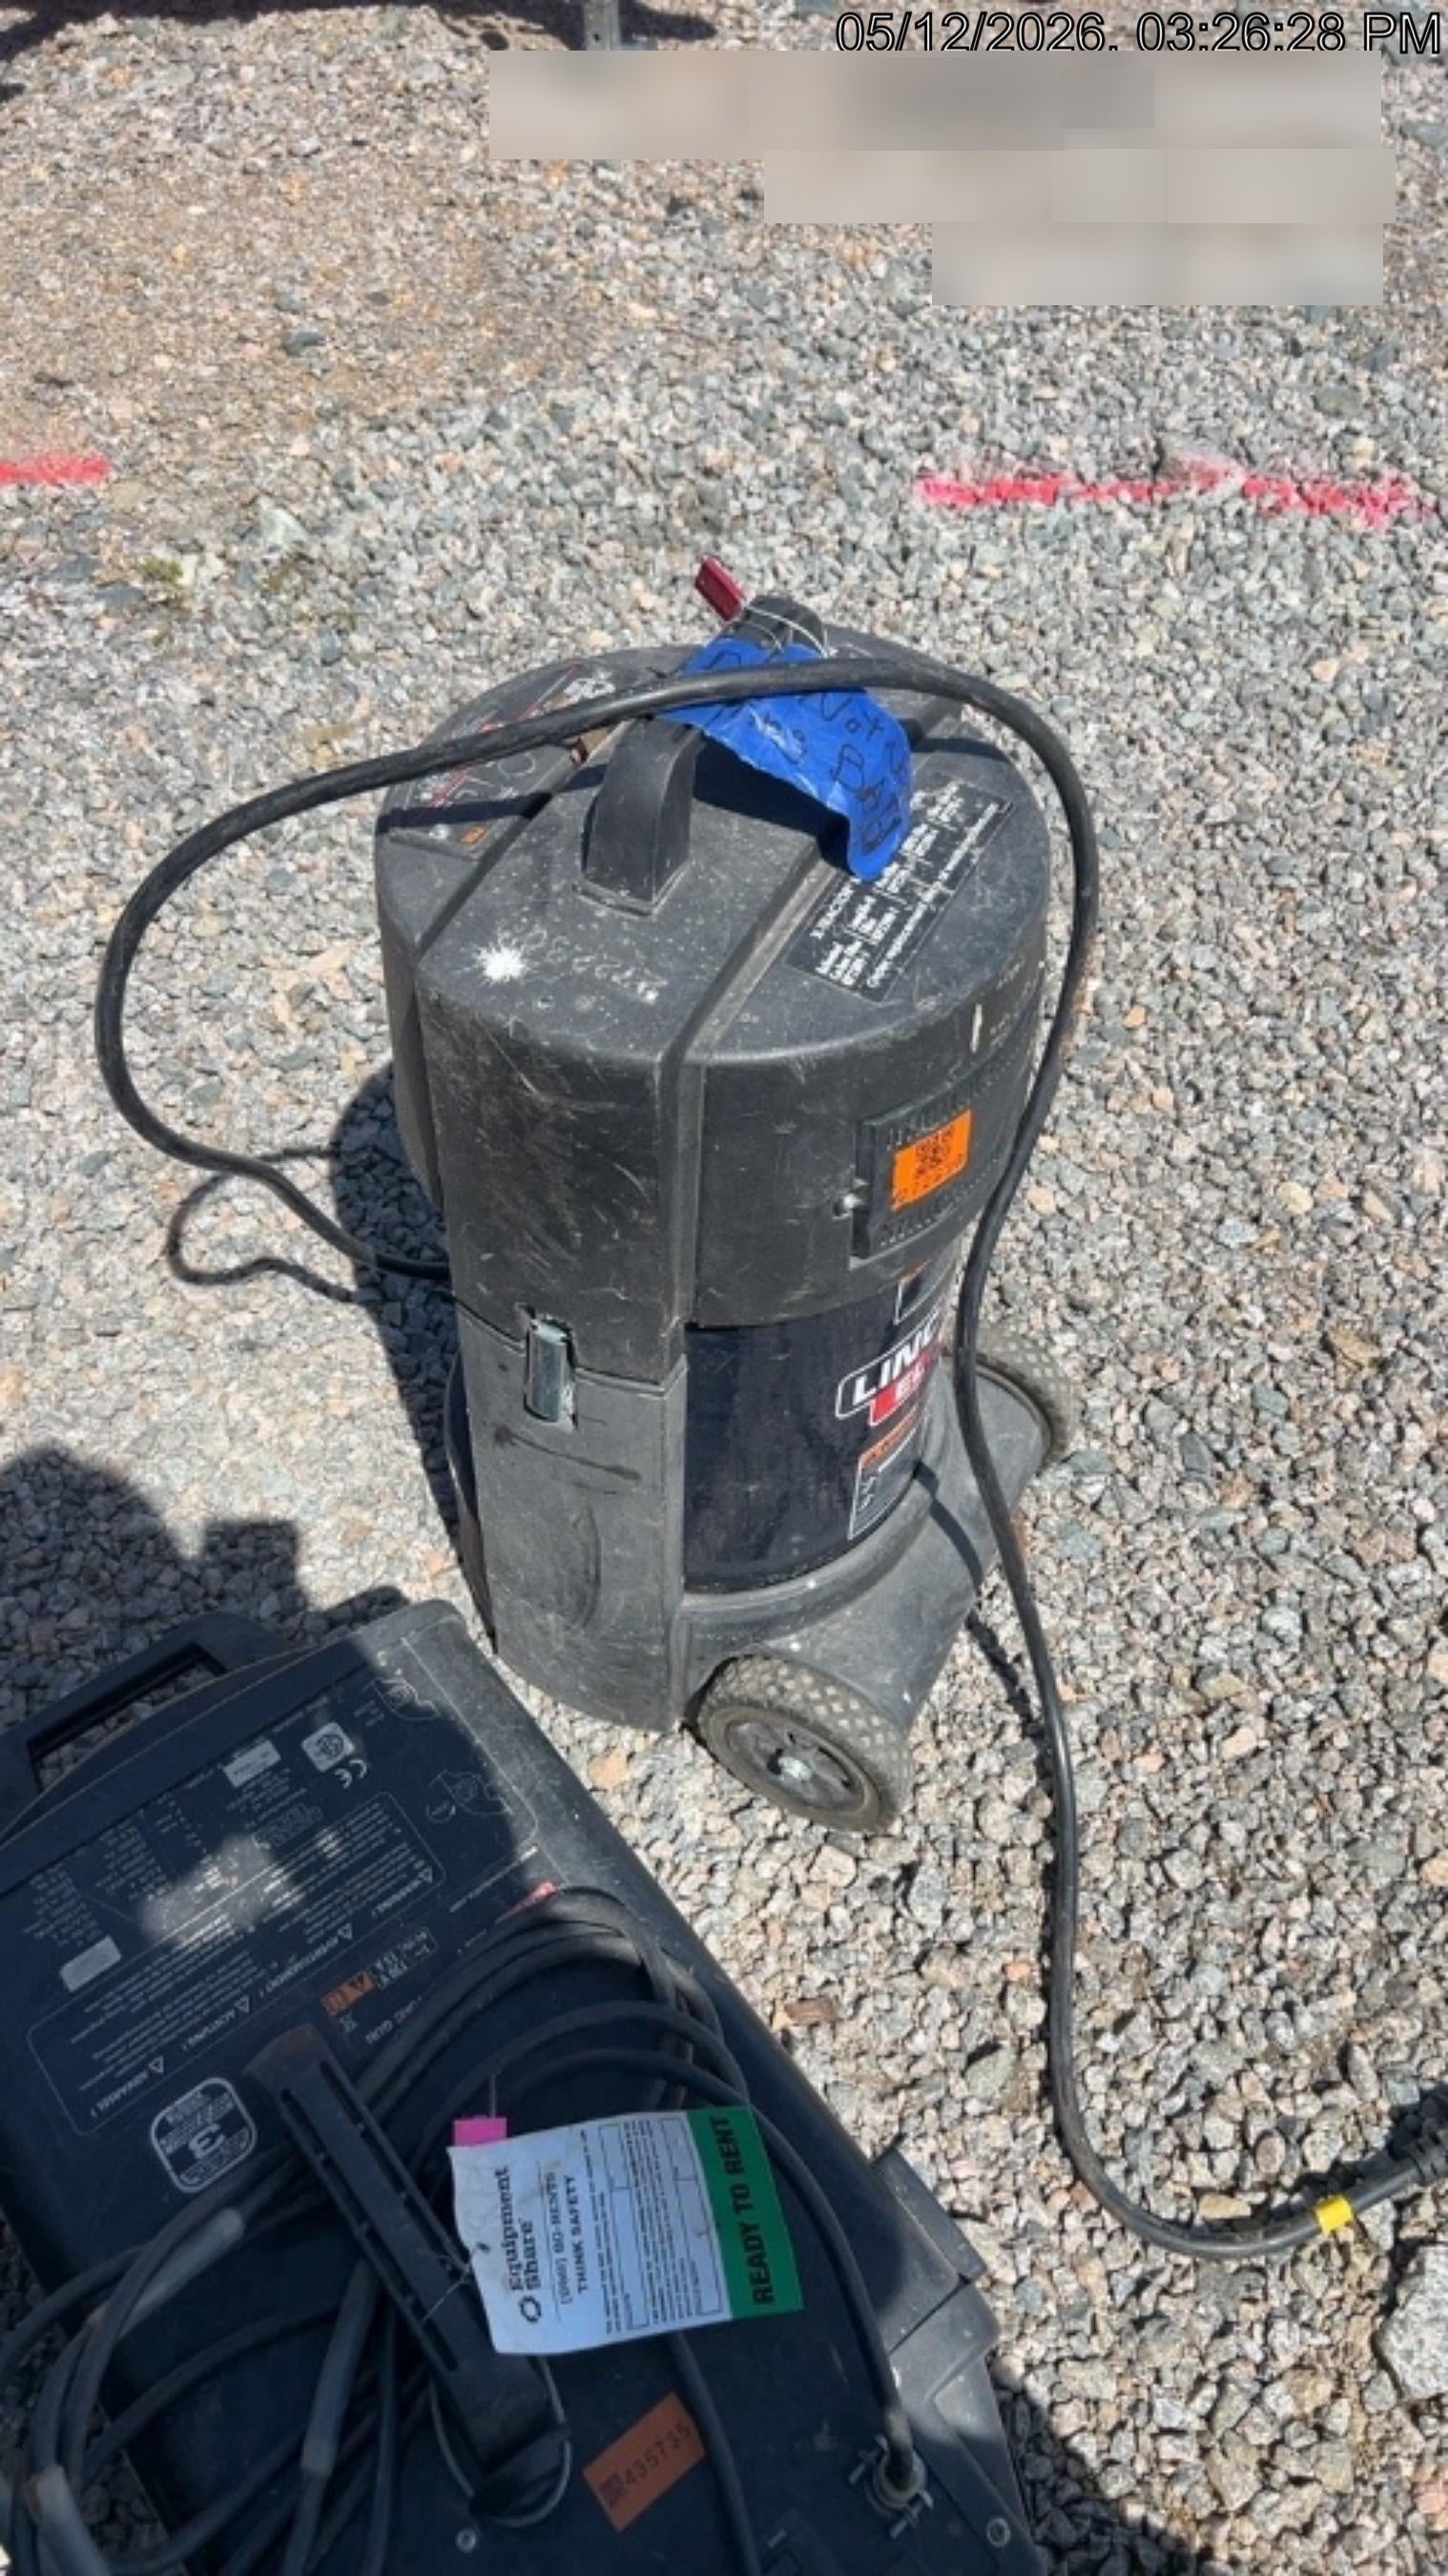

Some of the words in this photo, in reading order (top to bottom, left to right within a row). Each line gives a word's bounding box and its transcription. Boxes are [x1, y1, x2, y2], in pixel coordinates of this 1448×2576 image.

[334, 1758, 368, 1791] CE
[710, 2115, 745, 2176] RENT
[494, 2165, 525, 2292] Equipment
[564, 2173, 582, 2236] SAFETY
[730, 2182, 754, 2215] TO
[571, 2241, 589, 2294] THINK
[737, 2219, 775, 2306] READY
